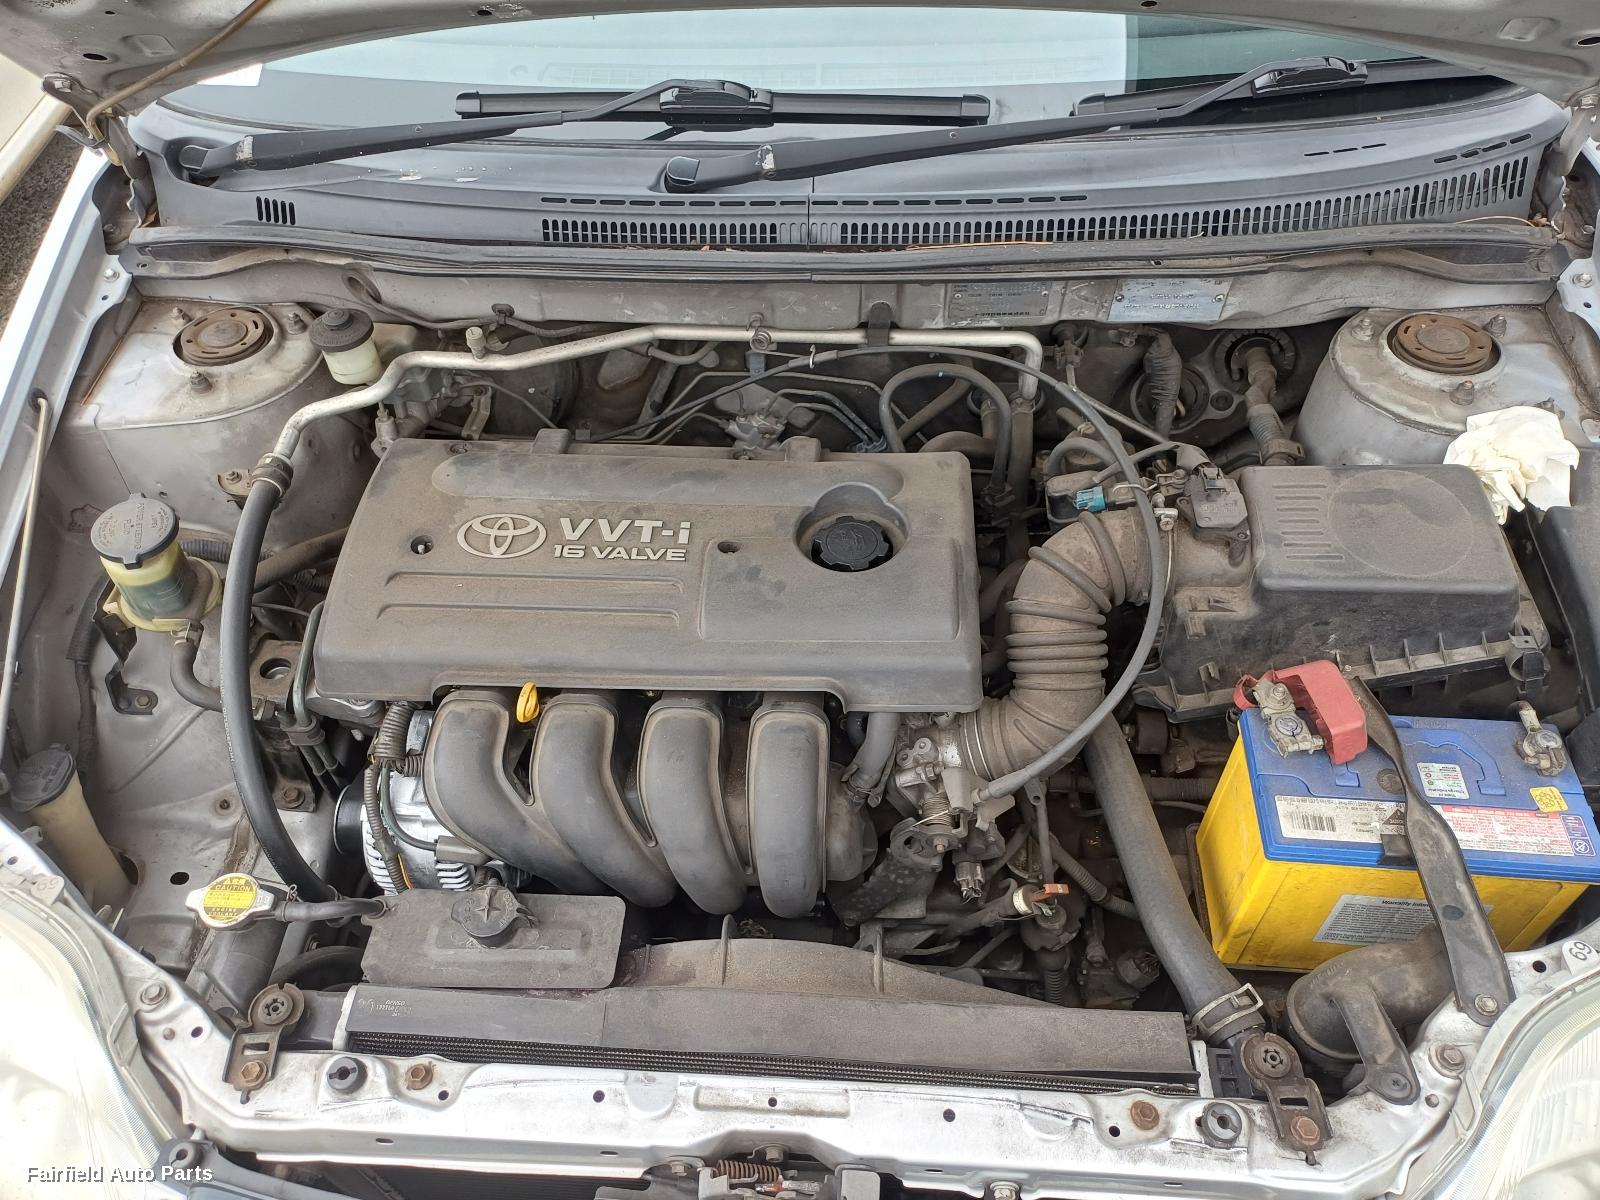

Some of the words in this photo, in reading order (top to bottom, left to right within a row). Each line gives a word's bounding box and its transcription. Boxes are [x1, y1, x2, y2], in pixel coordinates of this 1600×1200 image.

[560, 517, 691, 544] VVT-i
[553, 544, 586, 558] 16
[591, 546, 686, 561] VALVE
